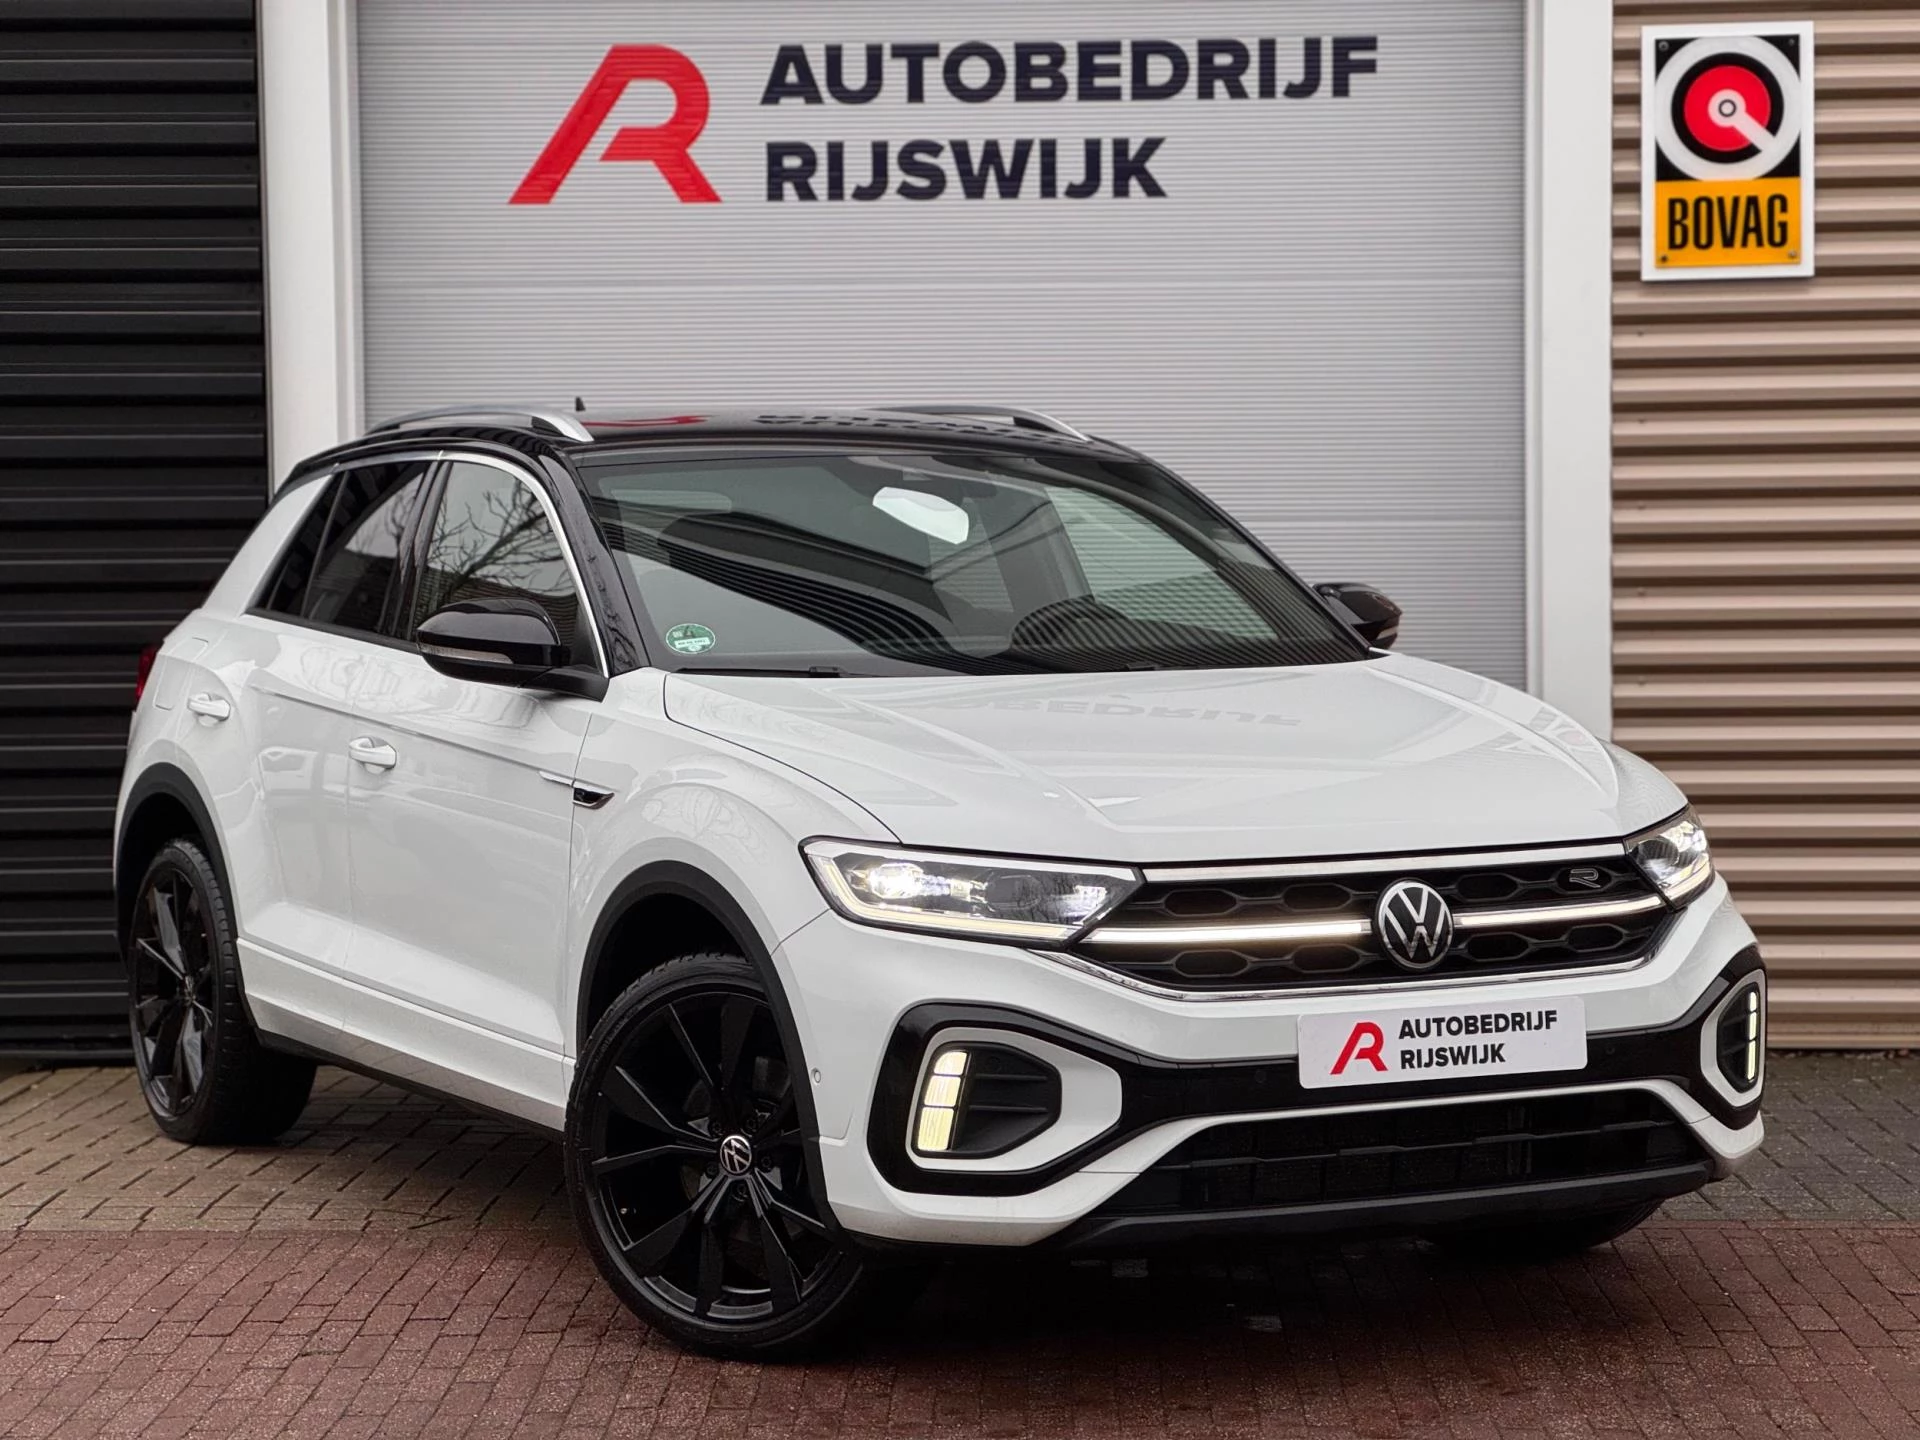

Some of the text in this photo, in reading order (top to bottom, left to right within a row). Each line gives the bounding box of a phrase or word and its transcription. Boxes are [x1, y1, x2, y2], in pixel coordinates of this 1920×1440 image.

[761, 36, 1377, 105] AUTOBEDRIJF
[767, 138, 1166, 201] RIJSWIJK
[1668, 194, 1787, 250] BOVAG
[1377, 879, 1453, 969] VW
[1399, 1010, 1556, 1039] AUTOBEDRIJF
[1401, 1043, 1506, 1069] RIJSWIJK
